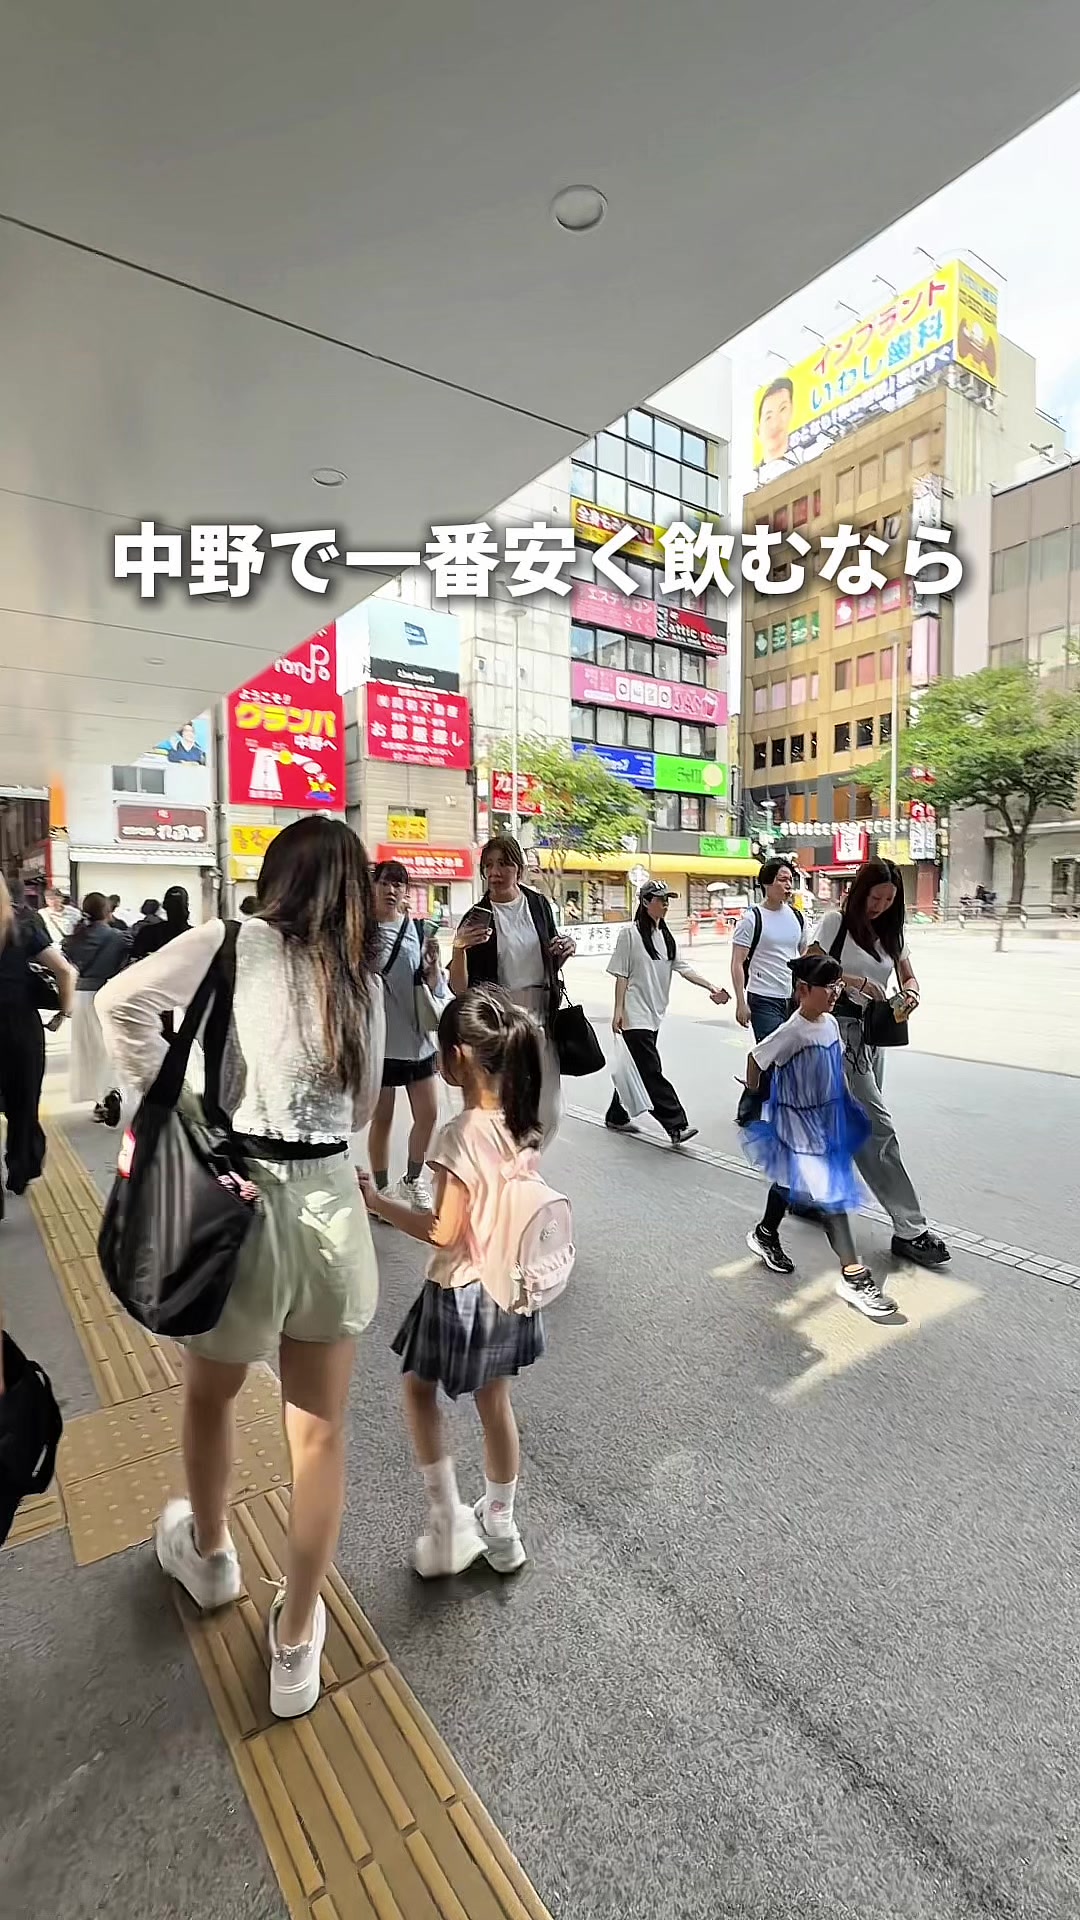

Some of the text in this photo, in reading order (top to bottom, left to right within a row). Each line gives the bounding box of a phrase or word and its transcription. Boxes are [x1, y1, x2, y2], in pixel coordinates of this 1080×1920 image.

[811, 309, 944, 411] いわし歯科
